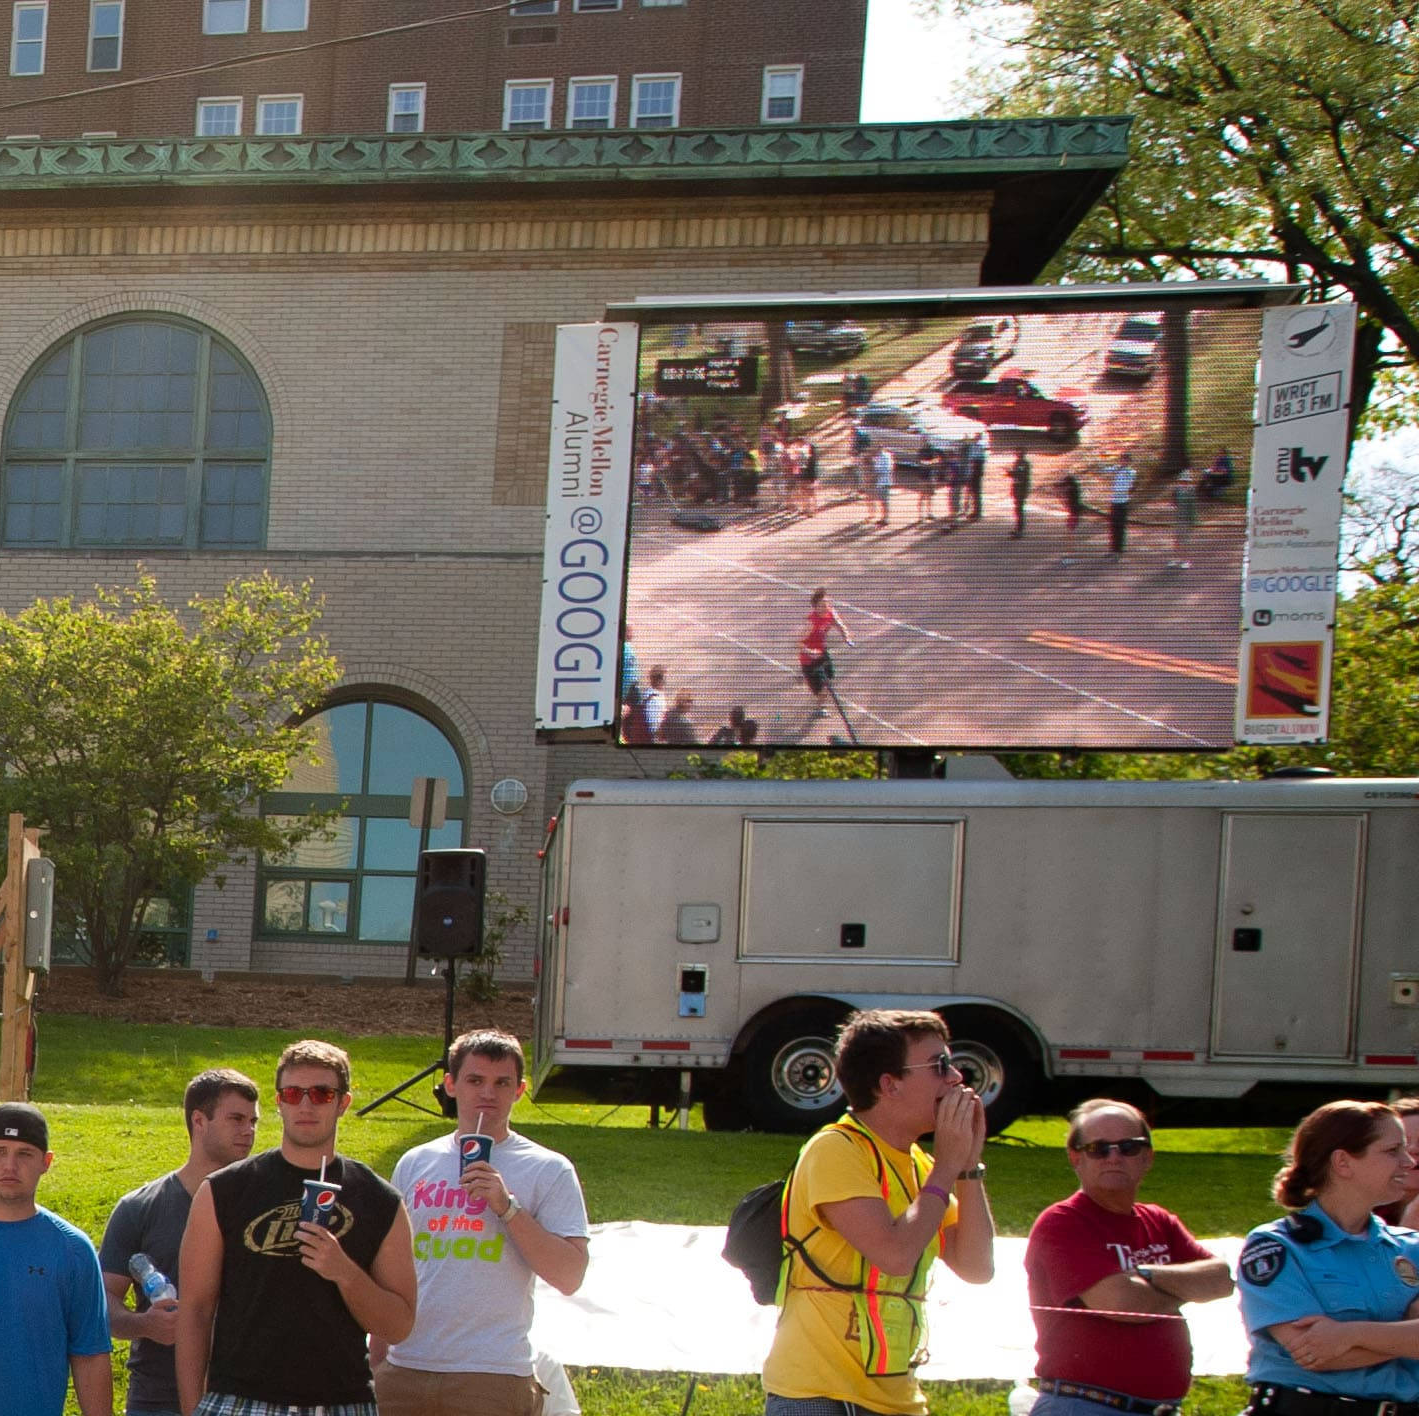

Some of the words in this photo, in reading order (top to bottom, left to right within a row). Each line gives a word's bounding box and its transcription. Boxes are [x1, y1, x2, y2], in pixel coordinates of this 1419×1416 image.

[587, 327, 619, 422] Carnegie
[1275, 380, 1319, 402] WRCT
[1273, 400, 1306, 419] 88.3
[1310, 393, 1333, 411] FM
[561, 411, 589, 498] Alumni
[589, 426, 614, 497] Mellon
[1276, 447, 1290, 484] cmu
[1248, 575, 1333, 593] @GOOGLE
[550, 506, 610, 722] @GOOGLE
[413, 1180, 488, 1216] King
[427, 1214, 450, 1232] of
[453, 1214, 485, 1232] the
[413, 1231, 505, 1263] Quad
